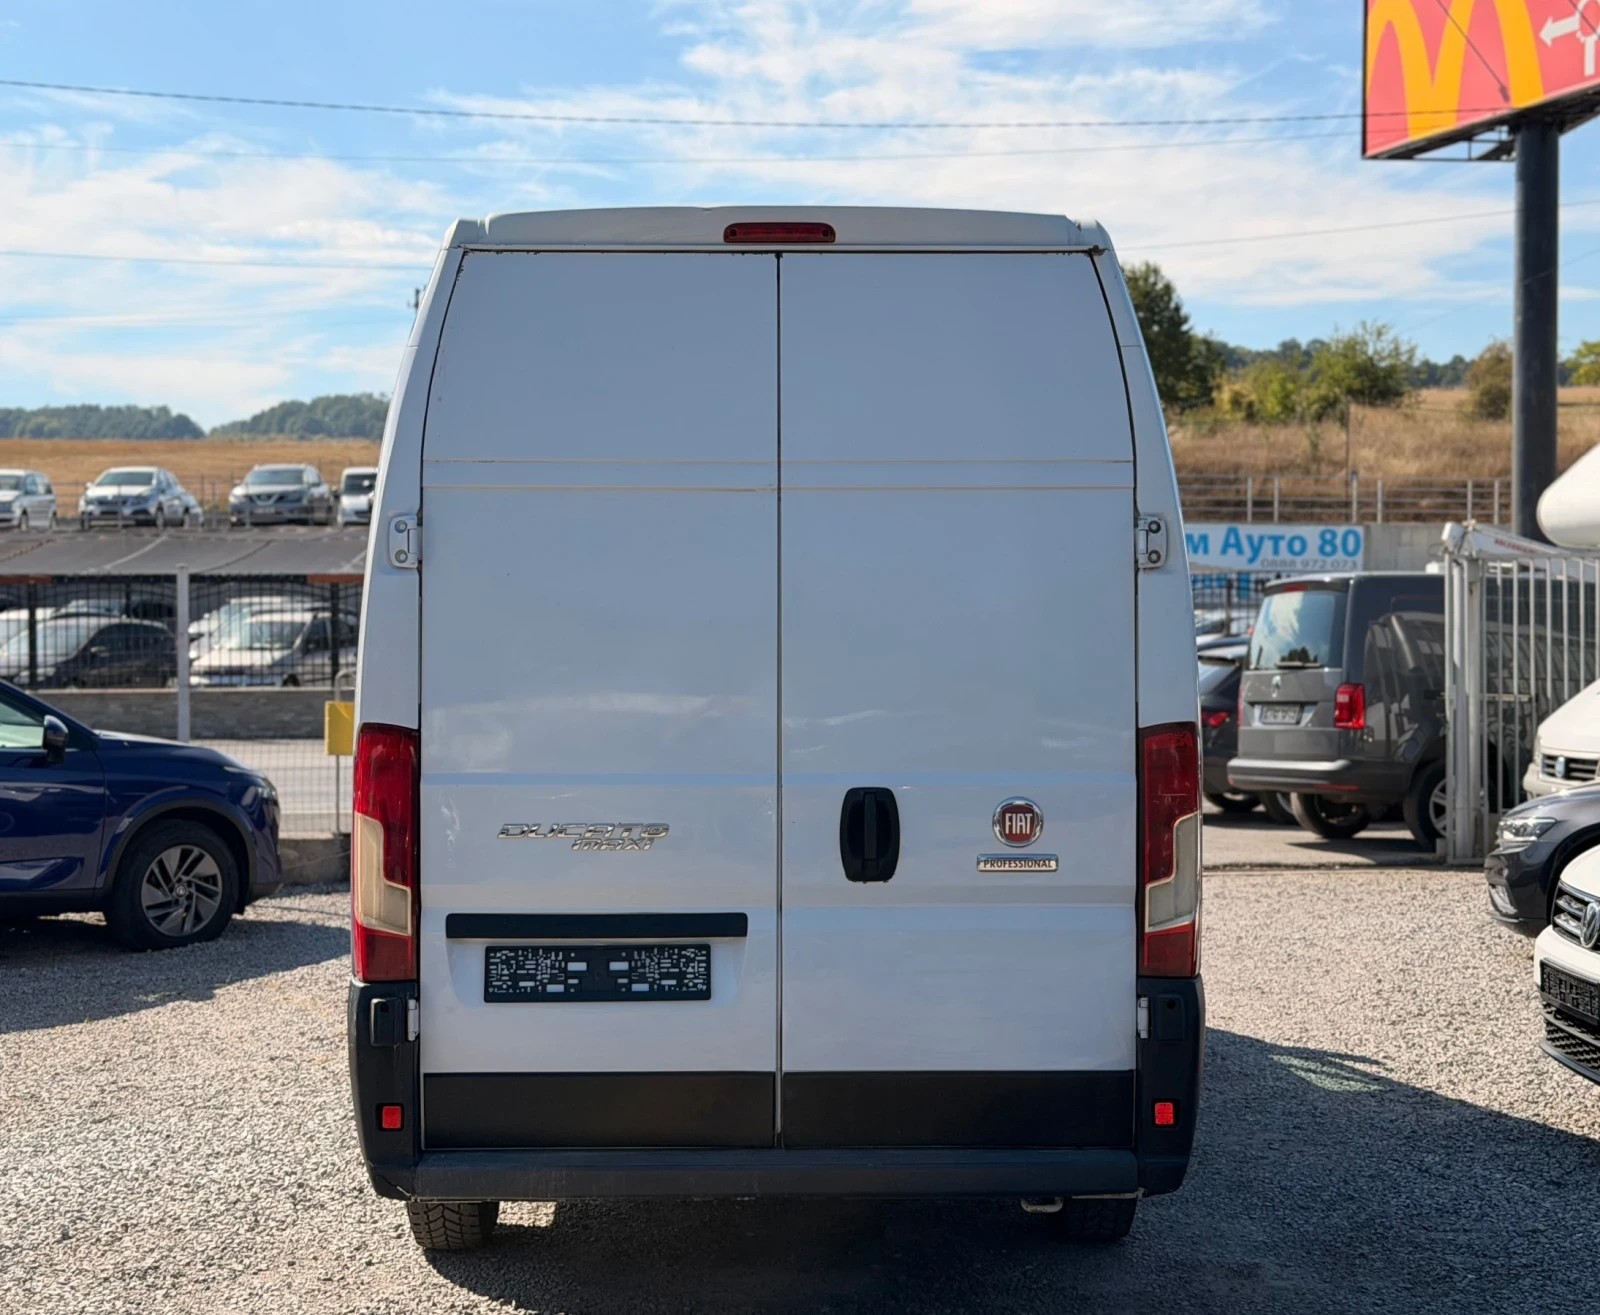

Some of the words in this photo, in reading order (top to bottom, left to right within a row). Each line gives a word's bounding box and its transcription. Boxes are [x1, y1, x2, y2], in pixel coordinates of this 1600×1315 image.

[1220, 526, 1308, 564] Ауто
[1318, 528, 1362, 557] 80
[1301, 559, 1326, 570] 972
[1331, 559, 1357, 570] 073
[497, 823, 670, 838] DUCATO
[1005, 813, 1033, 834] FIAT
[983, 859, 1053, 869] PROFESSIONAL
